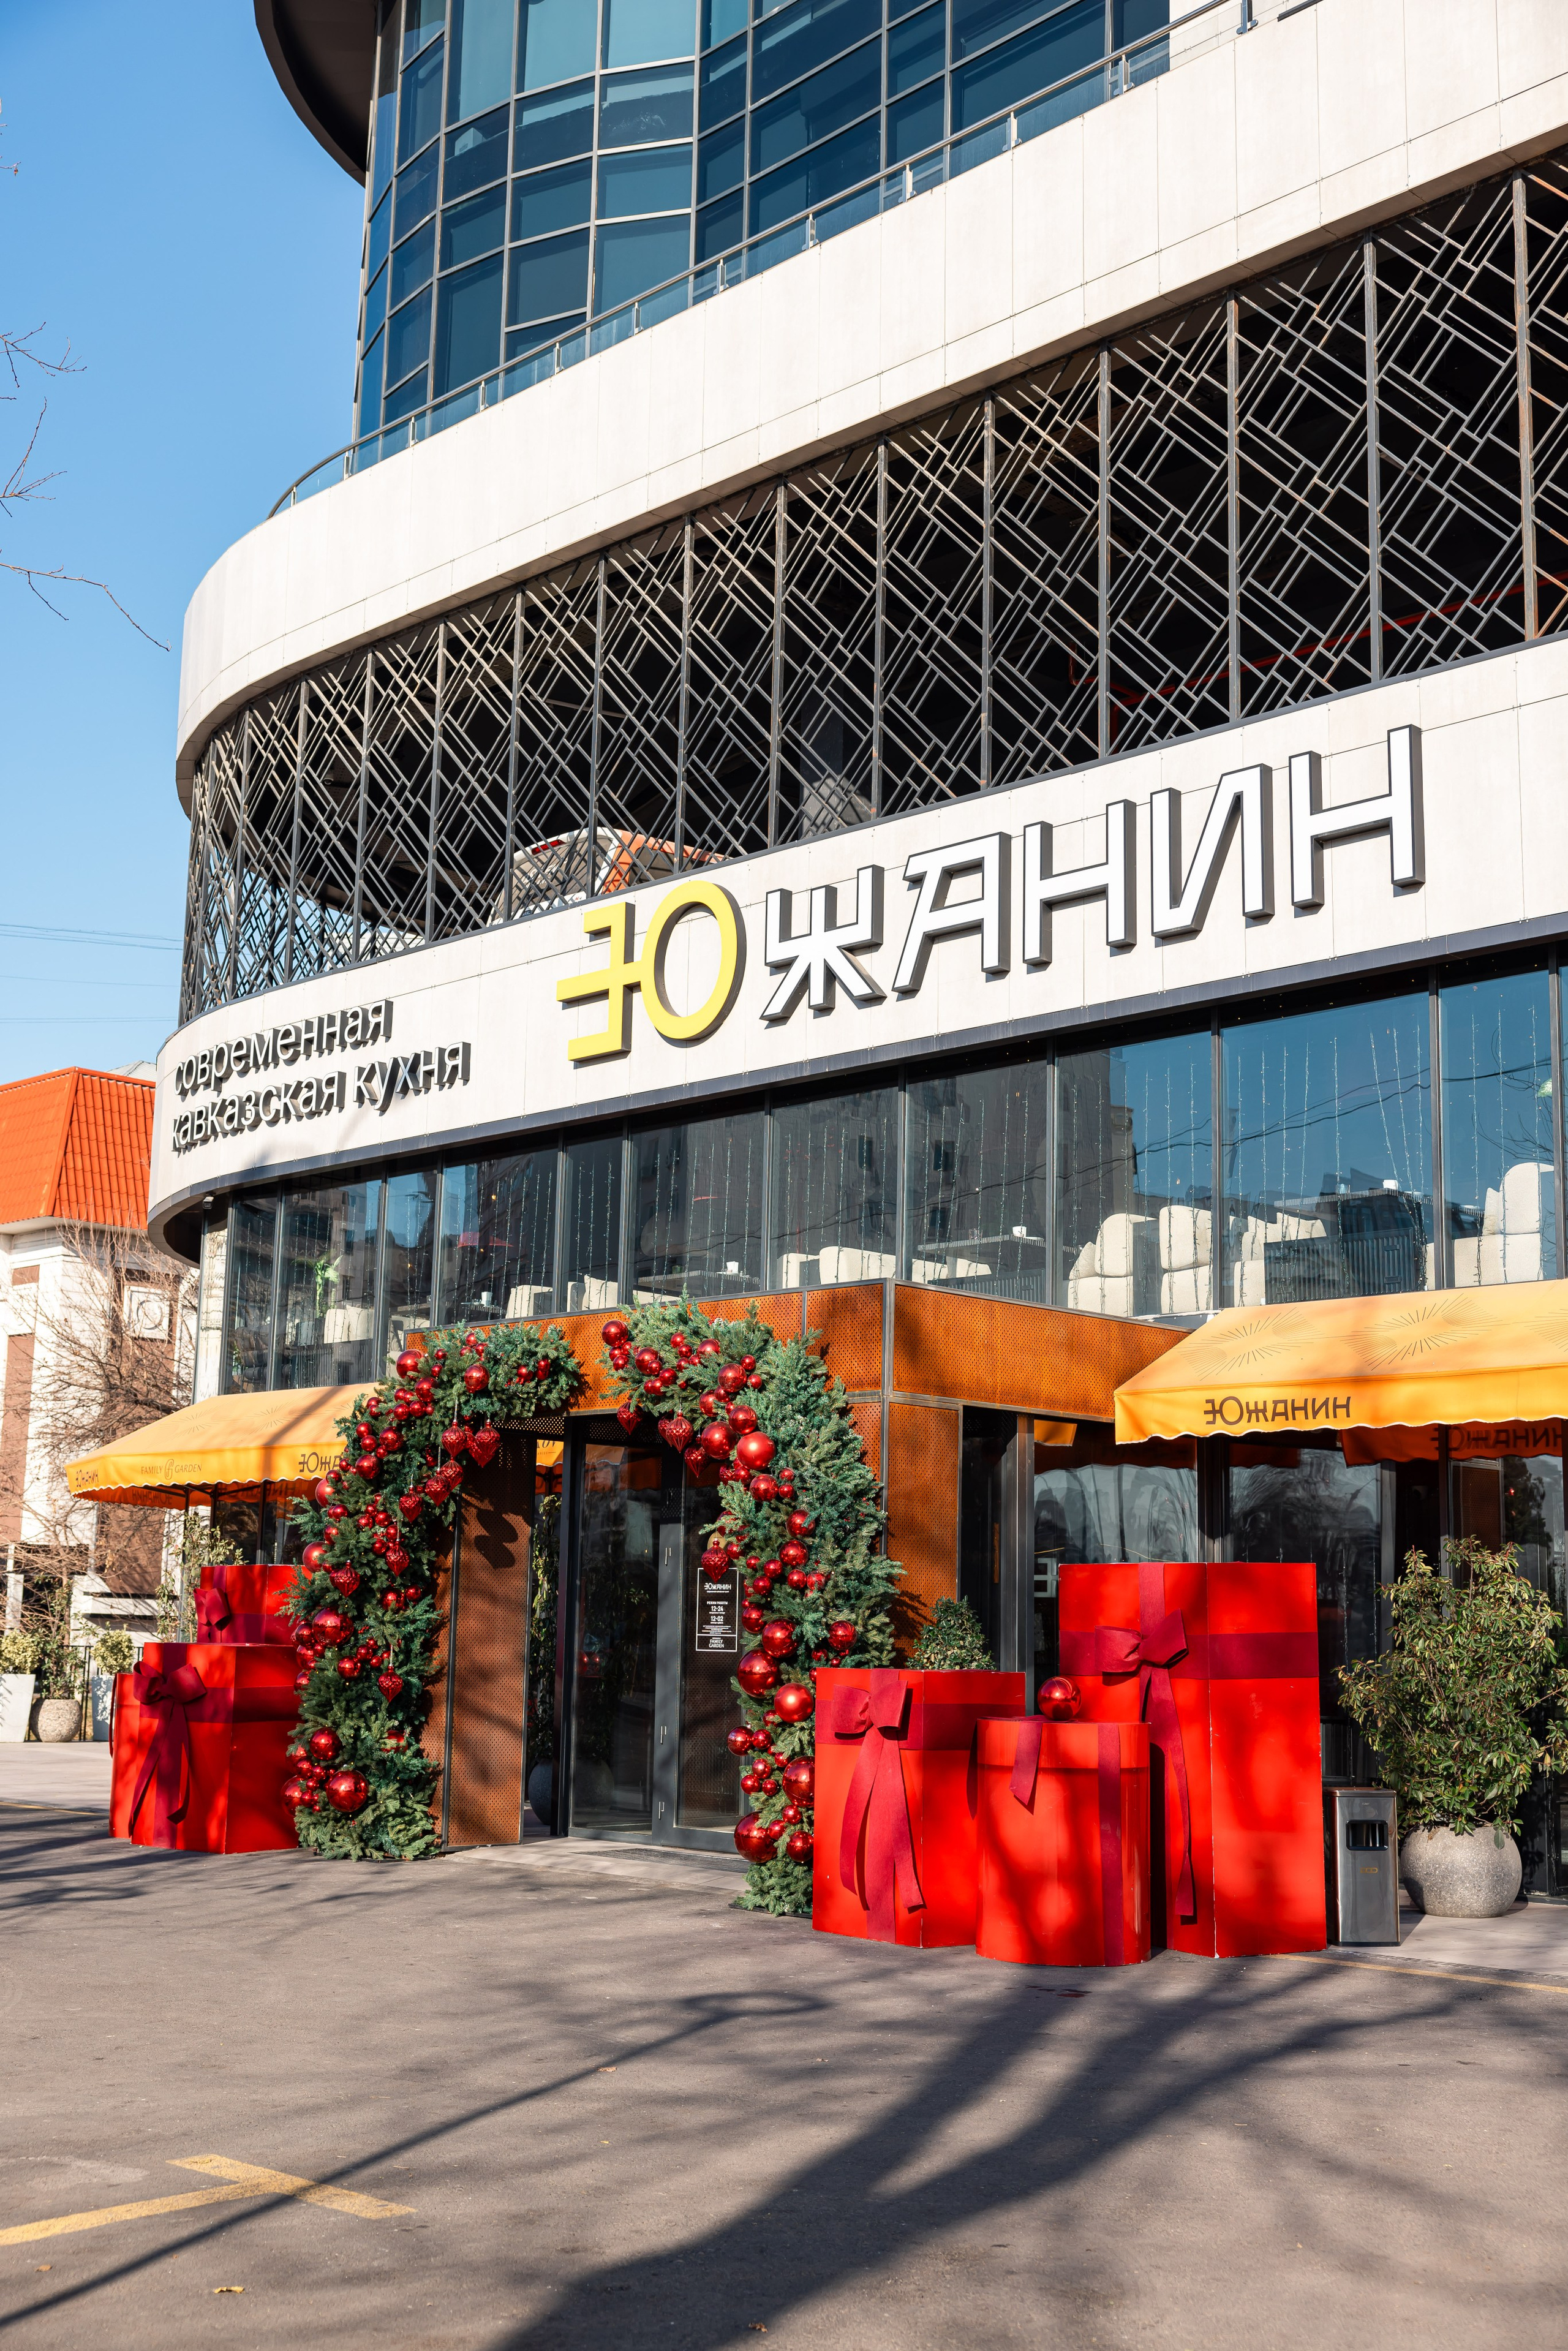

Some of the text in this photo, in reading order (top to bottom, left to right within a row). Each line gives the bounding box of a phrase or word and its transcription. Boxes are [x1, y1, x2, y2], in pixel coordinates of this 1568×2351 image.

[557, 724, 1424, 1062] ЮЖАНИН
[174, 999, 393, 1096] современная
[171, 1041, 471, 1152] кавказская кухня
[1204, 1395, 1351, 1426] ЮЖАНИН
[141, 1463, 202, 1475] FAMILY GARDEN
